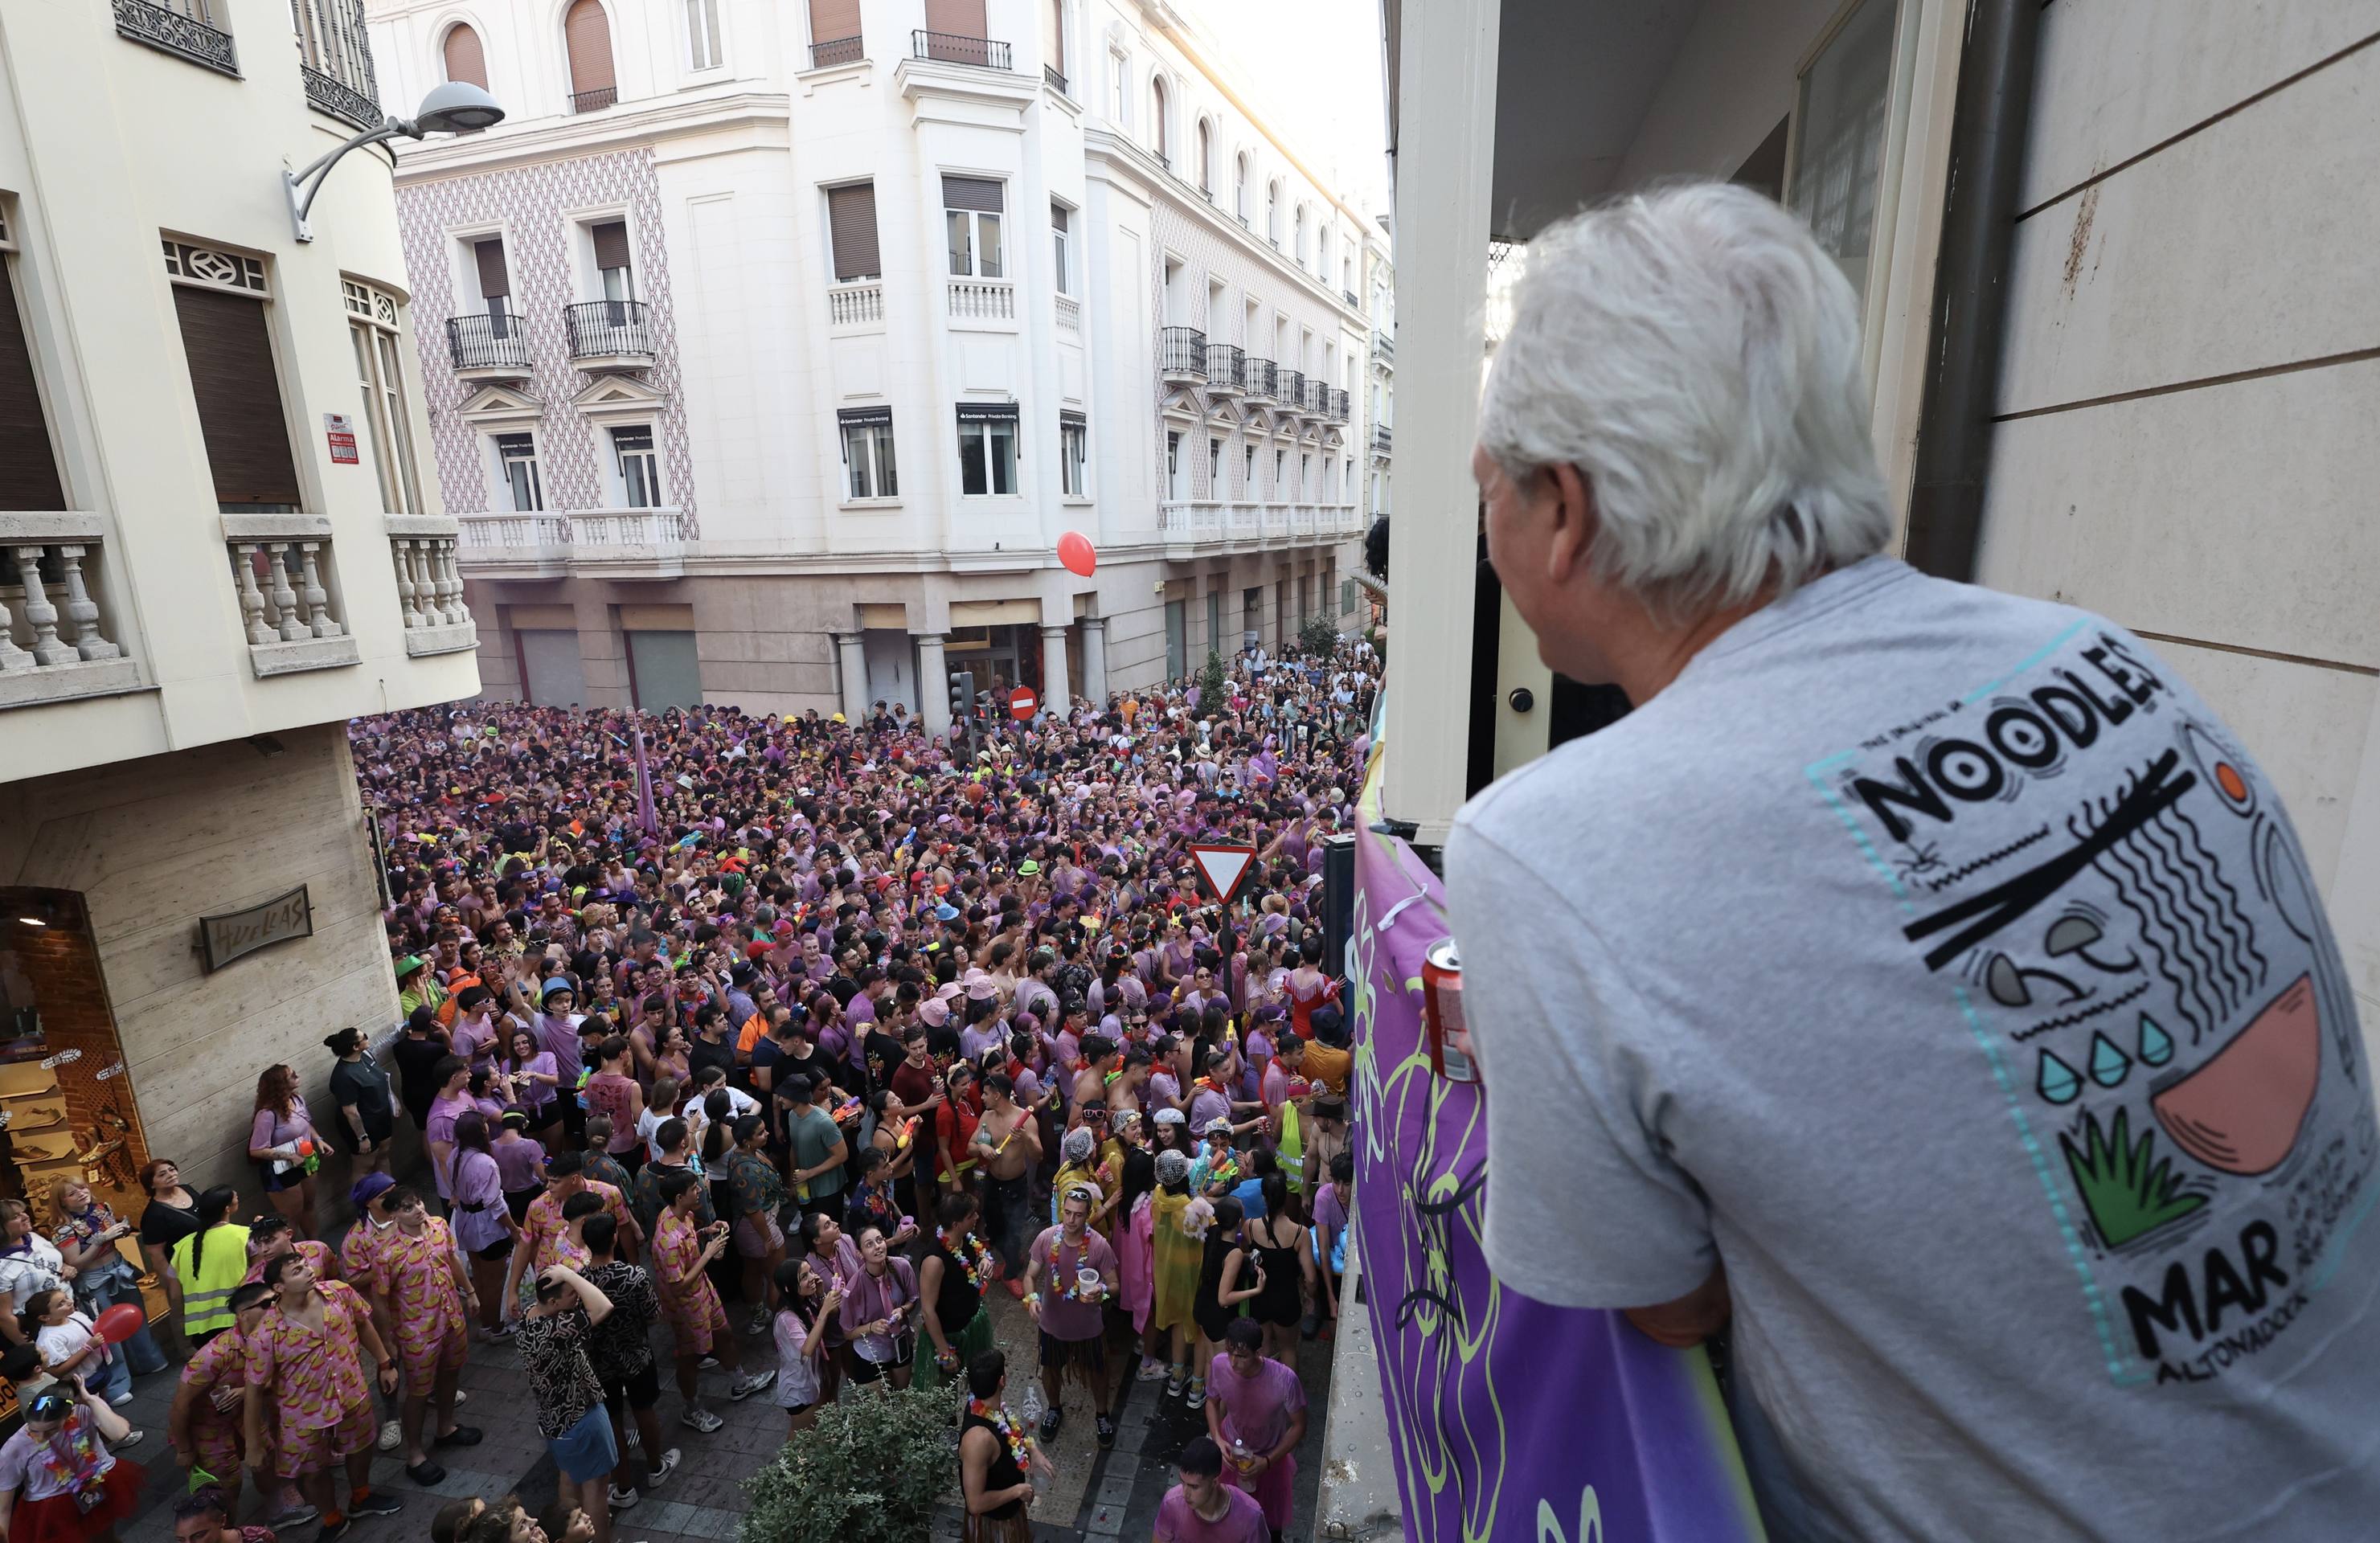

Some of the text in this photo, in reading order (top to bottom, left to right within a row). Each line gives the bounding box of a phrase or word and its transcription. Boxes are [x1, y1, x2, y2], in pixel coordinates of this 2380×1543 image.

[1854, 633, 2164, 841] NOODLES
[214, 897, 303, 956] HUELLAS
[2122, 1220, 2289, 1360] MAR
